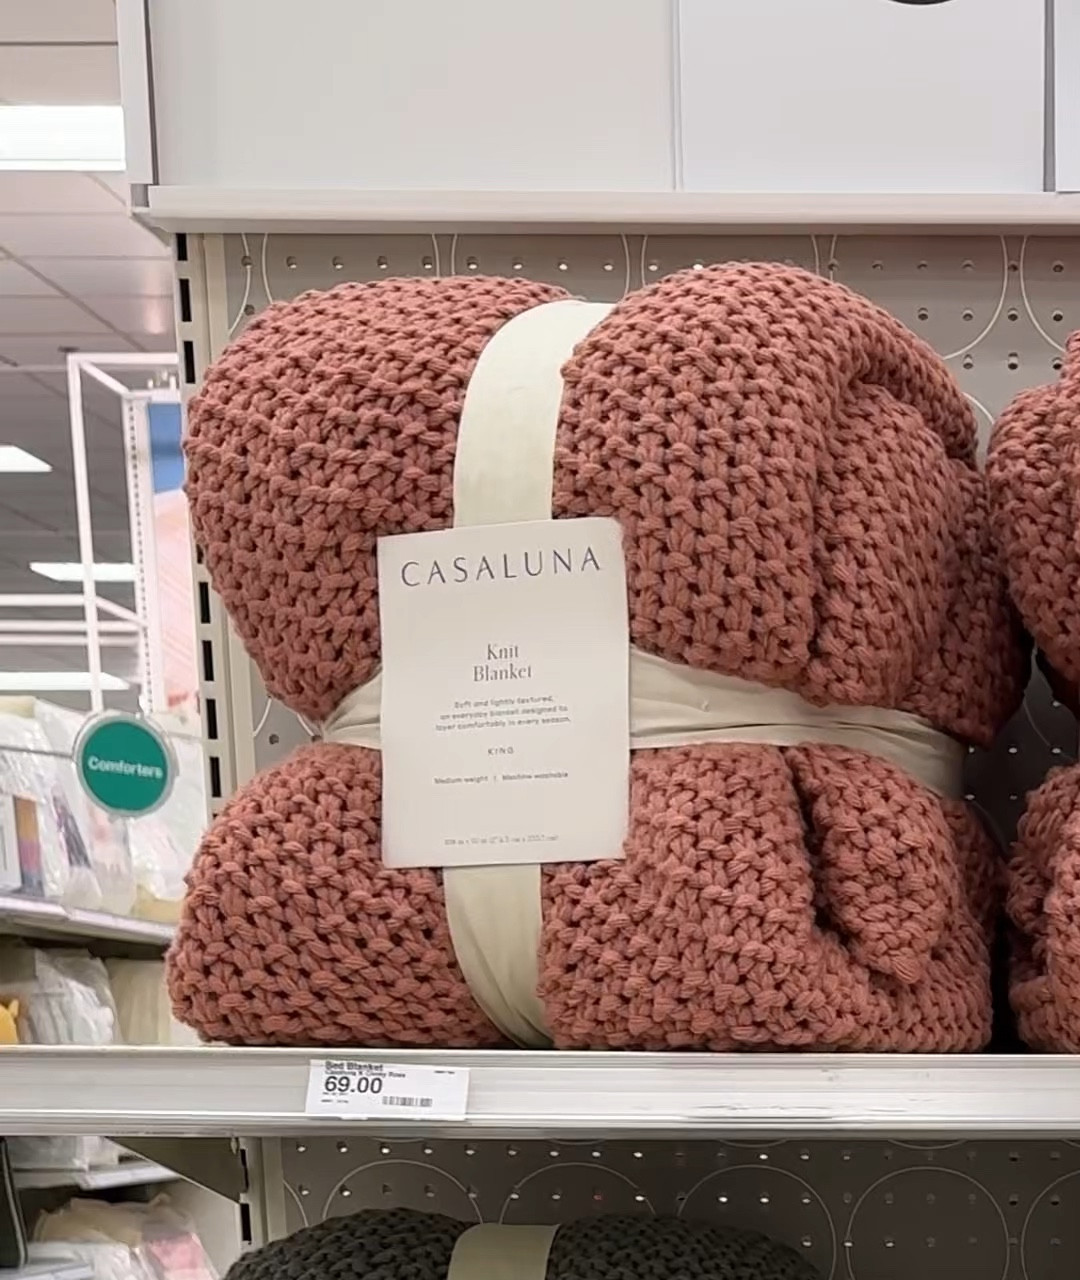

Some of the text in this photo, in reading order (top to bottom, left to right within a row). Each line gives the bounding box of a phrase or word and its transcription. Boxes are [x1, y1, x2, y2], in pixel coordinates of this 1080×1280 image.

[401, 547, 601, 587] CASALUNA
[487, 644, 518, 660] Knit
[474, 663, 531, 681] Blanket
[88, 755, 163, 779] Comforters
[324, 1076, 382, 1094] 69.00
